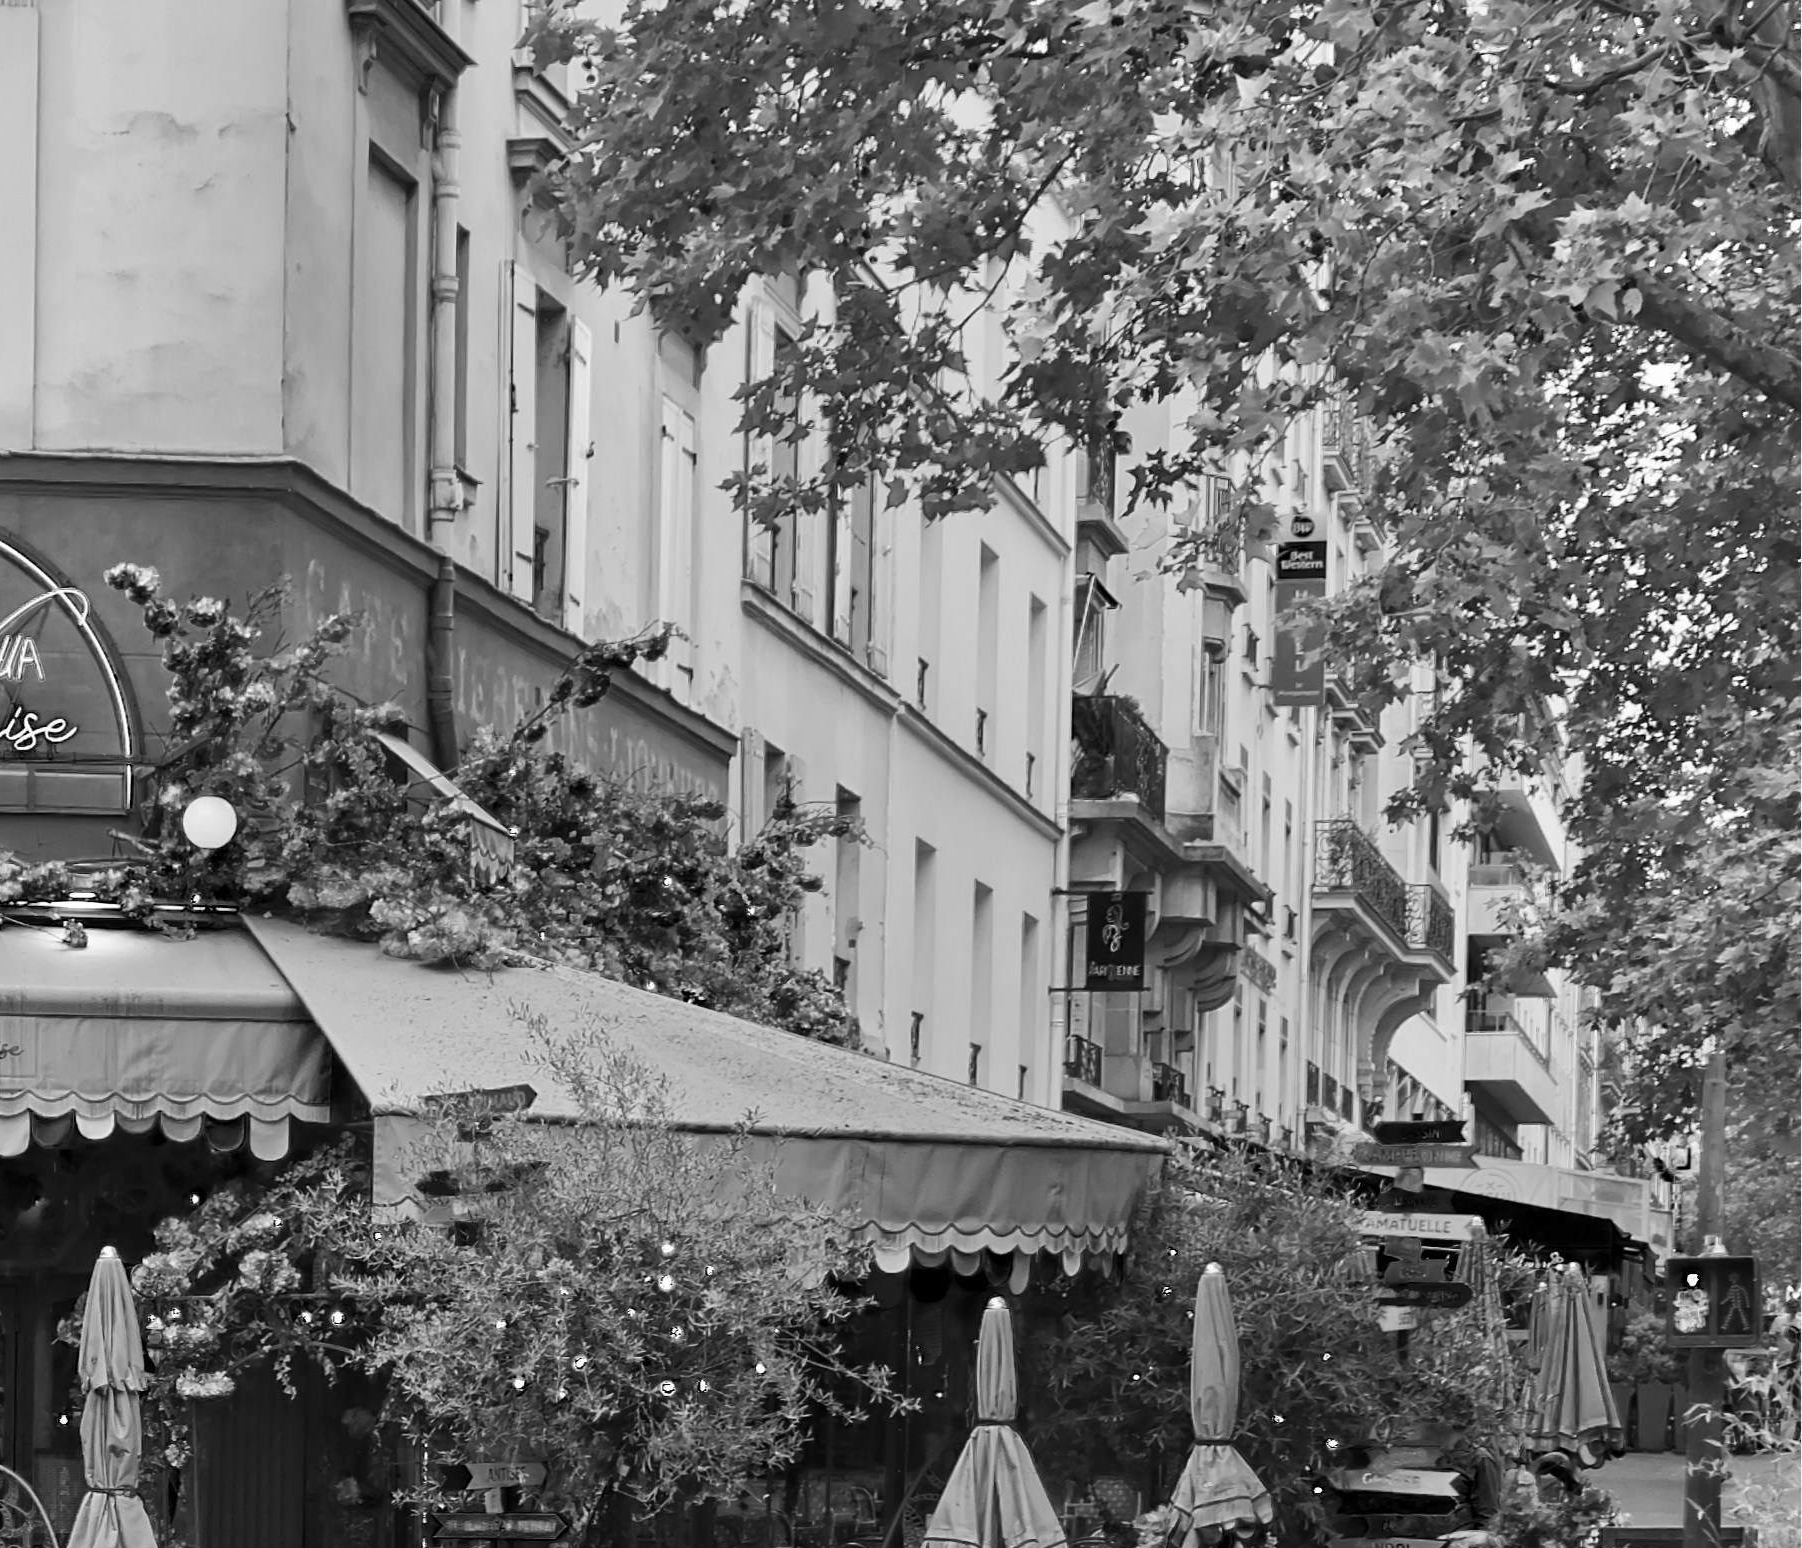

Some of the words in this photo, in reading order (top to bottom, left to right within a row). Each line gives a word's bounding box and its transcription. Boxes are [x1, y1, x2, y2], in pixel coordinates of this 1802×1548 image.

[1289, 550, 1314, 562] Best
[1280, 558, 1325, 571] Western
[1355, 1216, 1451, 1234] AMATUELLE
